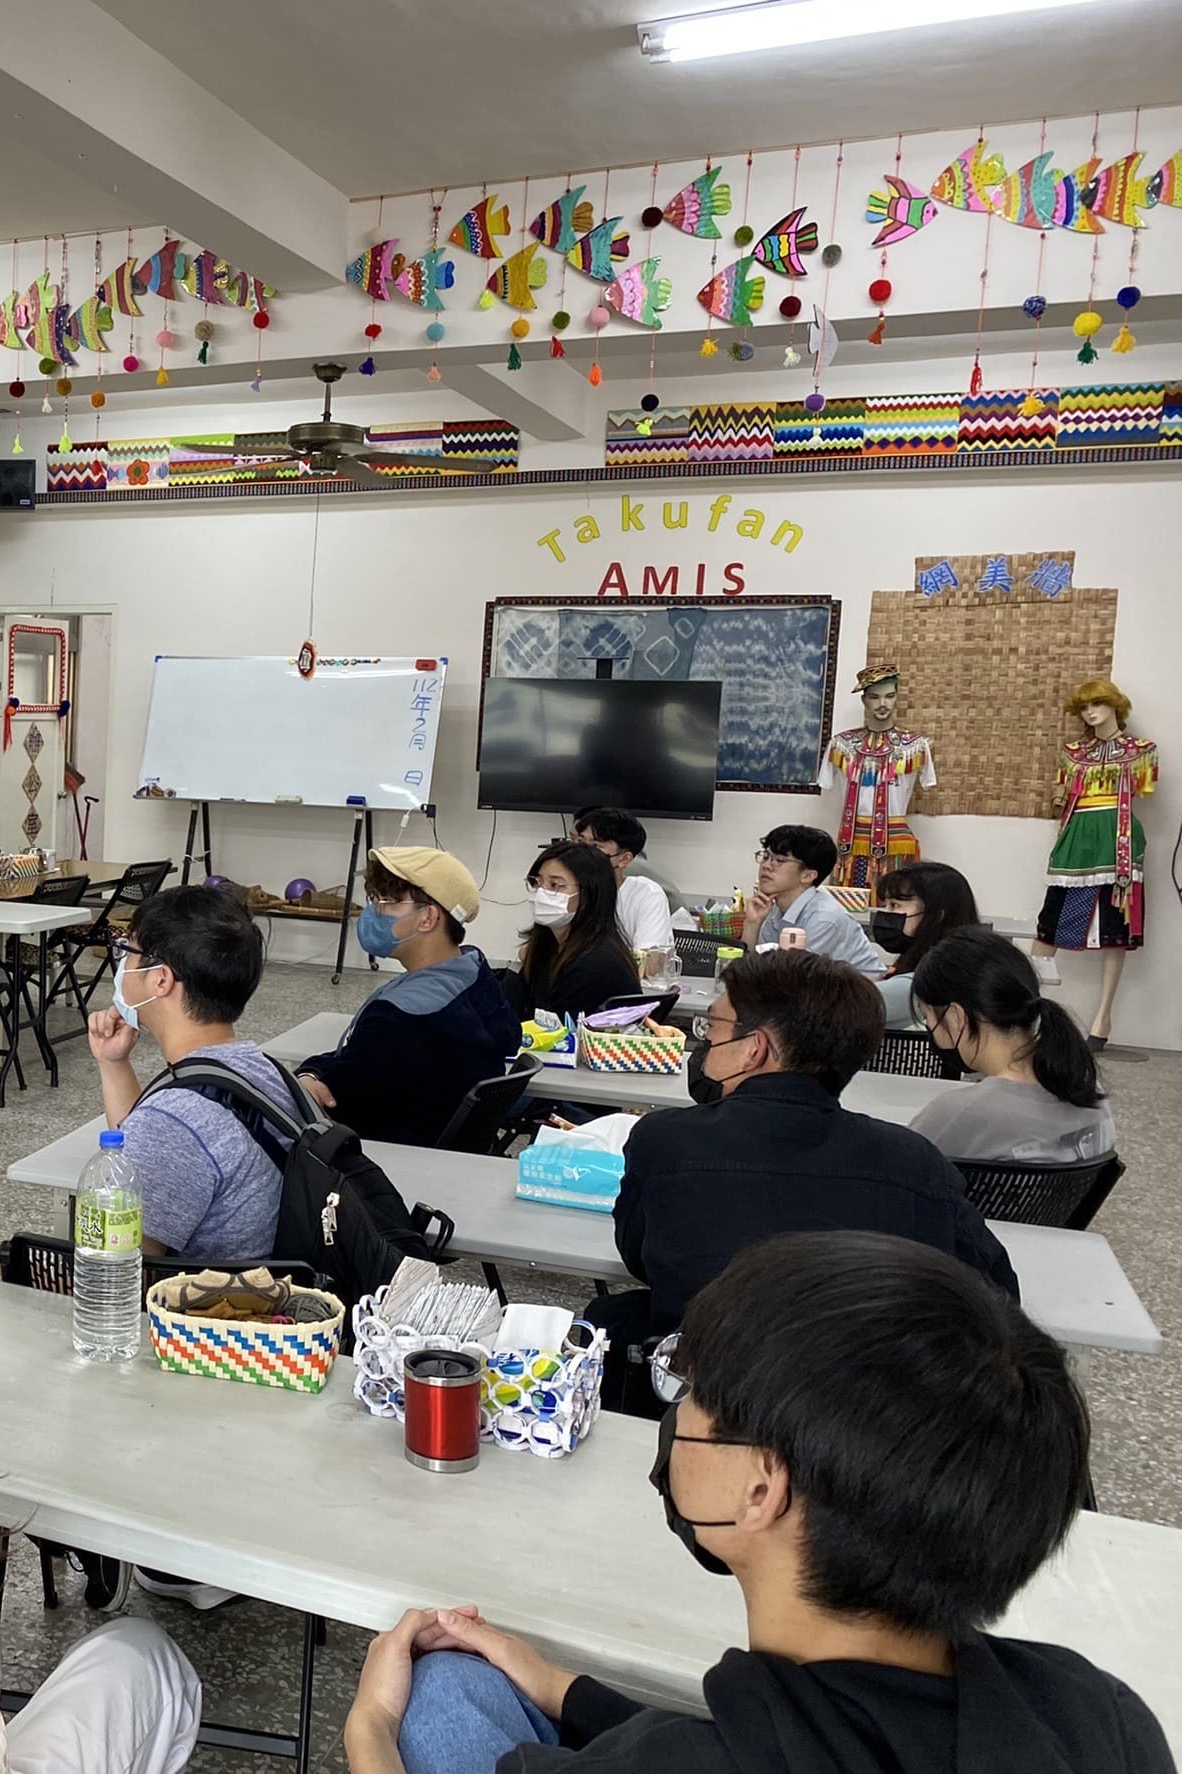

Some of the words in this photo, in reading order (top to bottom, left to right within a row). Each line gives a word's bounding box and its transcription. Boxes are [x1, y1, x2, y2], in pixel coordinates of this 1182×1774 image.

[536, 494, 804, 563] Takufan
[597, 562, 746, 596] AMIS
[919, 557, 1072, 598] 網美牆
